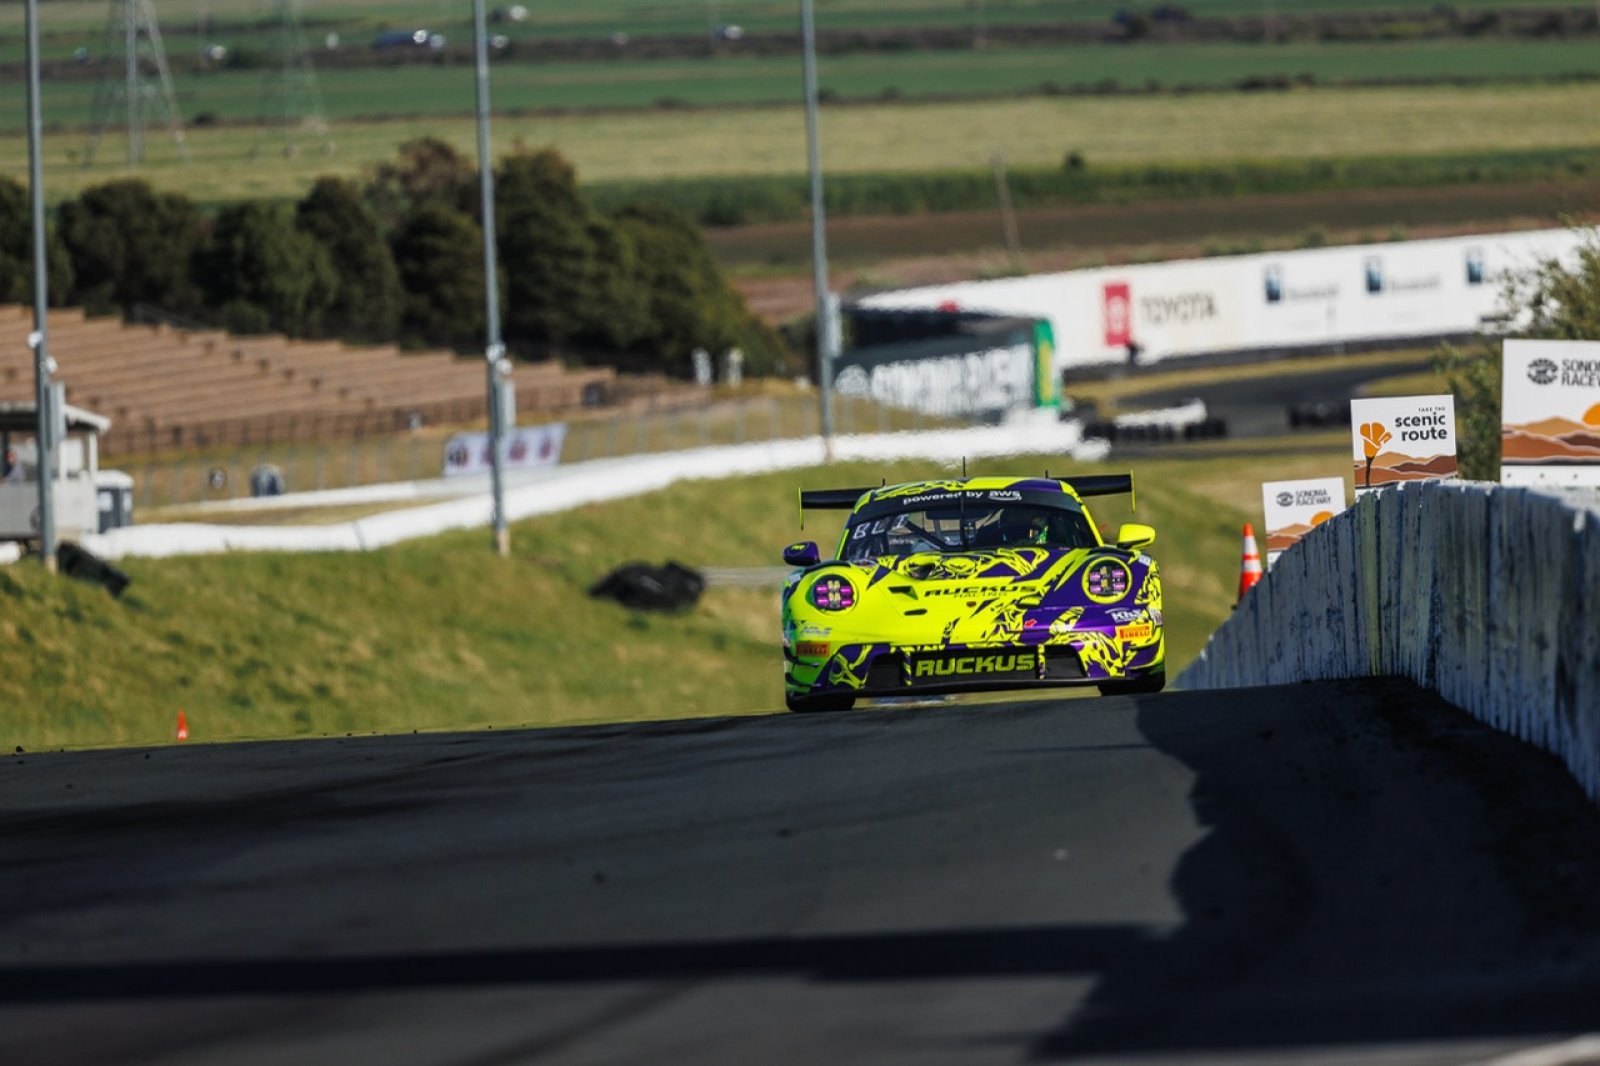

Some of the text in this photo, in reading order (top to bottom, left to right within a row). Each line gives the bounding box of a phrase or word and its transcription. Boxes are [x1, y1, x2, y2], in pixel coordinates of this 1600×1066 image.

[1140, 293, 1218, 326] TOYOTA
[1562, 372, 1600, 386] RACE
[1395, 411, 1446, 427] scenic
[1401, 426, 1447, 442] route
[903, 489, 1021, 505] powered by aws
[1295, 488, 1328, 498] SONOMA
[1295, 497, 1332, 506] RACEWAY
[924, 585, 1036, 598] RUCKUS
[1119, 625, 1150, 640] PIRELLI
[915, 653, 1036, 677] RUCKUS
